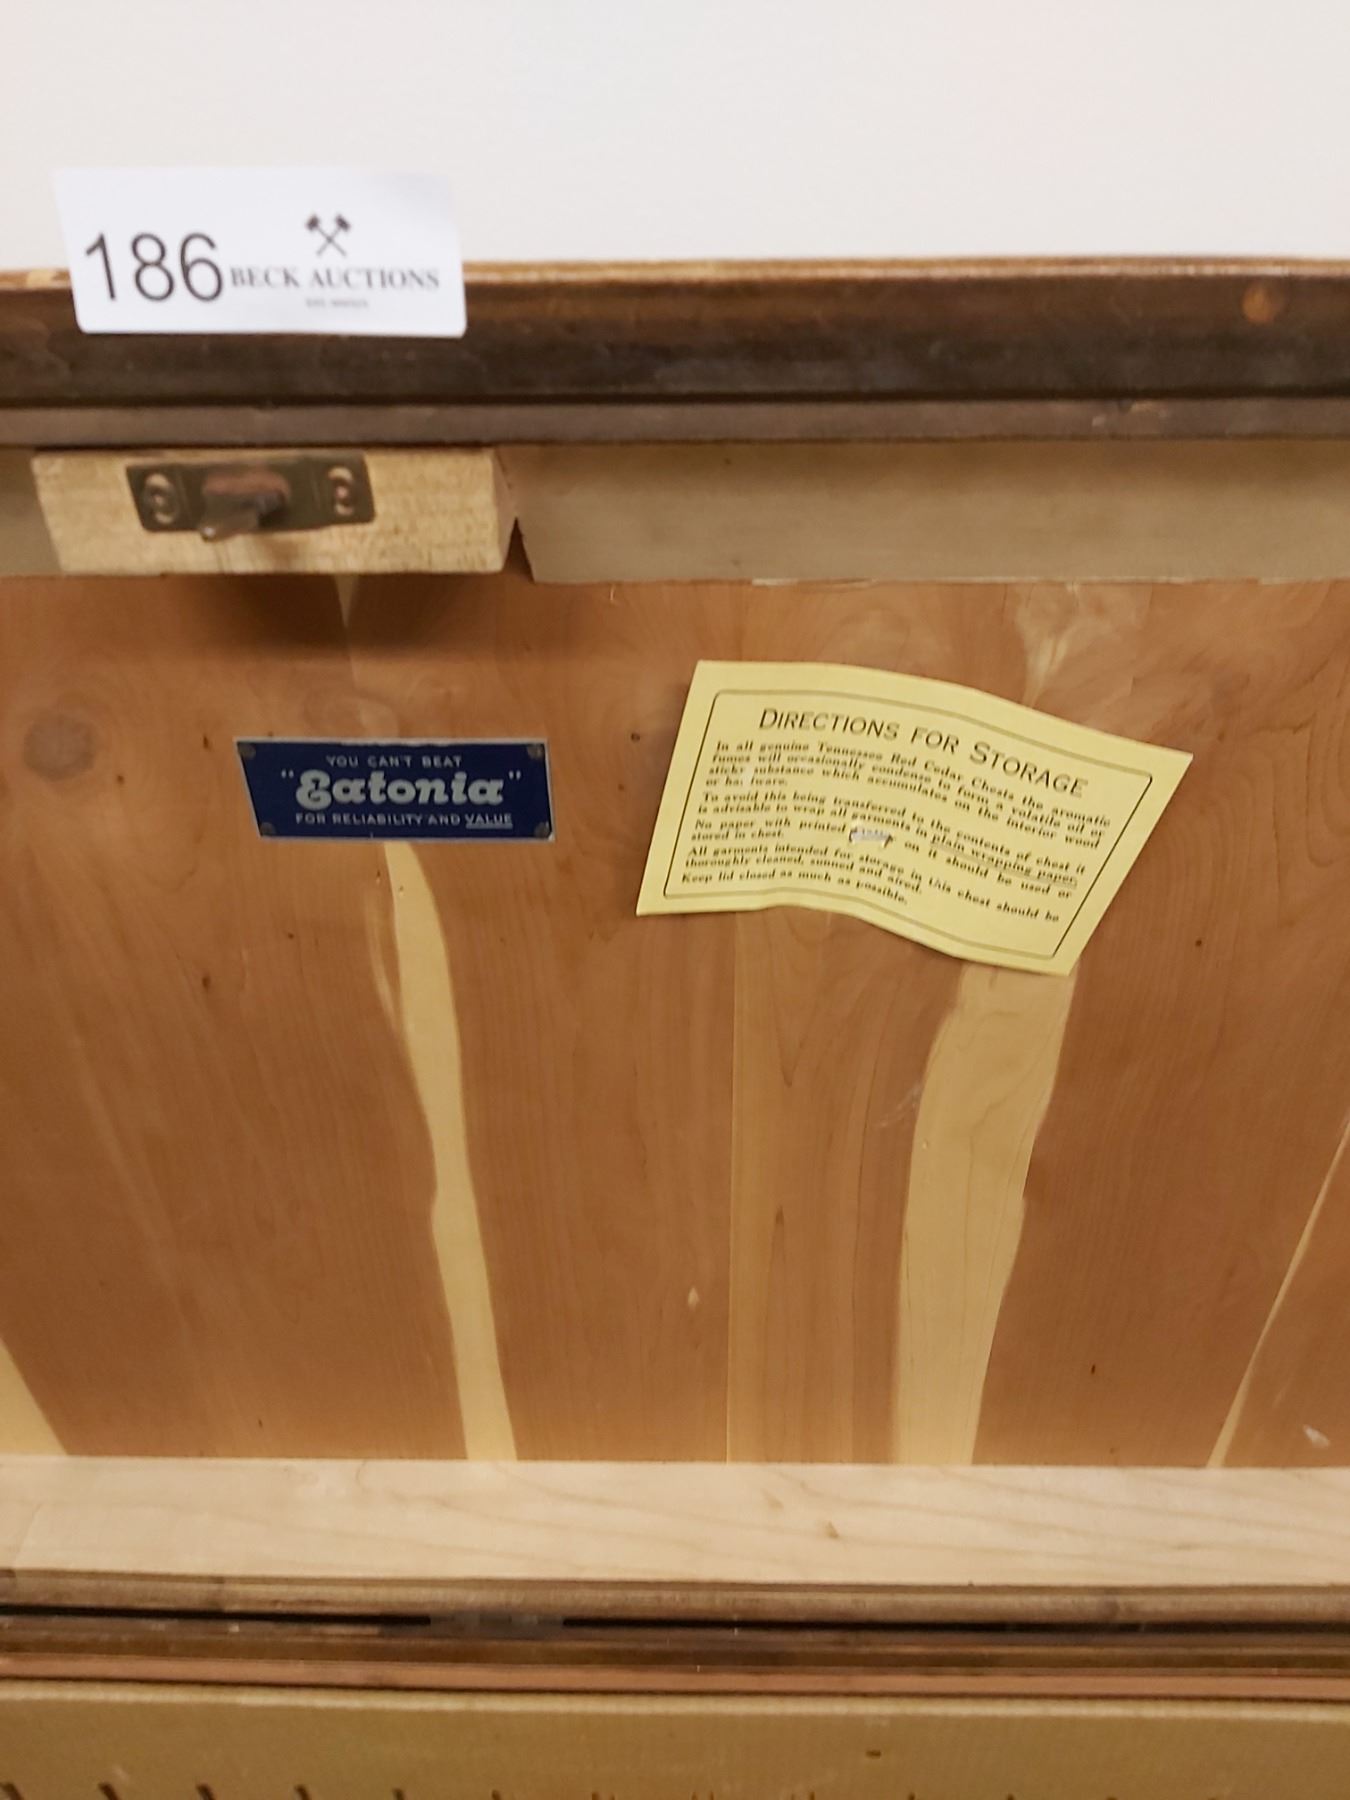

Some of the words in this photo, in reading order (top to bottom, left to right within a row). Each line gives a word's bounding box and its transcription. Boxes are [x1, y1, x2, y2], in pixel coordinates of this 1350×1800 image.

[85, 231, 224, 303] 186
[230, 268, 300, 289] BECK
[309, 267, 441, 290] AUCTIONS
[326, 755, 359, 767] YOU
[367, 756, 412, 767] CAN'T
[422, 756, 462, 767] BEAT
[717, 741, 729, 751] In
[737, 741, 753, 751] all
[760, 743, 809, 753] genuine
[818, 742, 883, 760] Tennessee
[890, 753, 917, 767] Red
[924, 760, 962, 781] Cedar
[972, 773, 1015, 800] Chests
[1022, 794, 1044, 810] the
[1052, 805, 1110, 826] aromatic
[759, 708, 900, 741] DIRECTIONS
[910, 726, 960, 755] FOR
[970, 741, 1088, 798] STORAGE
[296, 813, 326, 825] FOR
[333, 813, 423, 826] RELIABILITY
[428, 814, 461, 826] AND
[466, 814, 512, 826] VALUE
[712, 755, 751, 764] fumes
[758, 752, 780, 762] will
[787, 755, 863, 769] occasionally
[871, 765, 931, 784] condense
[938, 778, 951, 790] to
[957, 784, 989, 806] form
[996, 801, 1003, 810] a
[1011, 805, 1060, 828] volatile
[1068, 820, 1085, 832] oil
[1090, 829, 1103, 837] or
[753, 766, 814, 775] substance
[822, 768, 860, 780] which
[867, 776, 948, 802] accumulates
[955, 800, 970, 810] on
[978, 805, 999, 821] the
[1006, 816, 1058, 840] interior
[1066, 834, 1101, 850] wood
[686, 857, 749, 868] thoroughly
[810, 859, 854, 870] sunned
[859, 866, 883, 878] and
[692, 831, 729, 841] stored
[734, 830, 746, 839] in
[695, 820, 712, 829] No
[720, 820, 755, 831] paper
[765, 818, 791, 828] with
[800, 821, 845, 832] printed
[904, 840, 920, 852] on
[928, 848, 938, 859] it
[946, 855, 989, 878] should
[998, 872, 1012, 885] be
[1021, 882, 1050, 894] used
[1058, 890, 1072, 898] or
[703, 792, 718, 801] To
[724, 793, 758, 801] avoid
[765, 791, 786, 801] this
[793, 793, 825, 803] being
[834, 796, 905, 818] transferred
[913, 812, 924, 823] to
[930, 819, 950, 834] the
[956, 828, 1010, 856] contents
[1016, 850, 1031, 860] of
[1037, 856, 1070, 872] chest
[1076, 865, 1086, 874] it
[712, 804, 771, 814] advisable
[776, 803, 786, 812] to
[794, 806, 824, 815] wrap
[830, 808, 846, 817] all
[852, 813, 911, 830] garments
[916, 826, 928, 837] in
[931, 834, 965, 852] plain
[971, 848, 1032, 875] wrapping
[682, 873, 713, 884] Keep
[718, 871, 734, 881] lid
[739, 870, 775, 880] closed
[781, 870, 792, 878] as
[798, 871, 831, 883] much
[838, 876, 850, 885] as
[688, 846, 707, 855] All
[713, 846, 768, 857] garments
[775, 845, 828, 857] intended
[834, 848, 851, 859] for
[859, 854, 904, 876] storage
[910, 870, 922, 881] in
[929, 876, 951, 892] this
[957, 889, 990, 908] chest
[997, 900, 1039, 919] should
[1045, 910, 1059, 922] be
